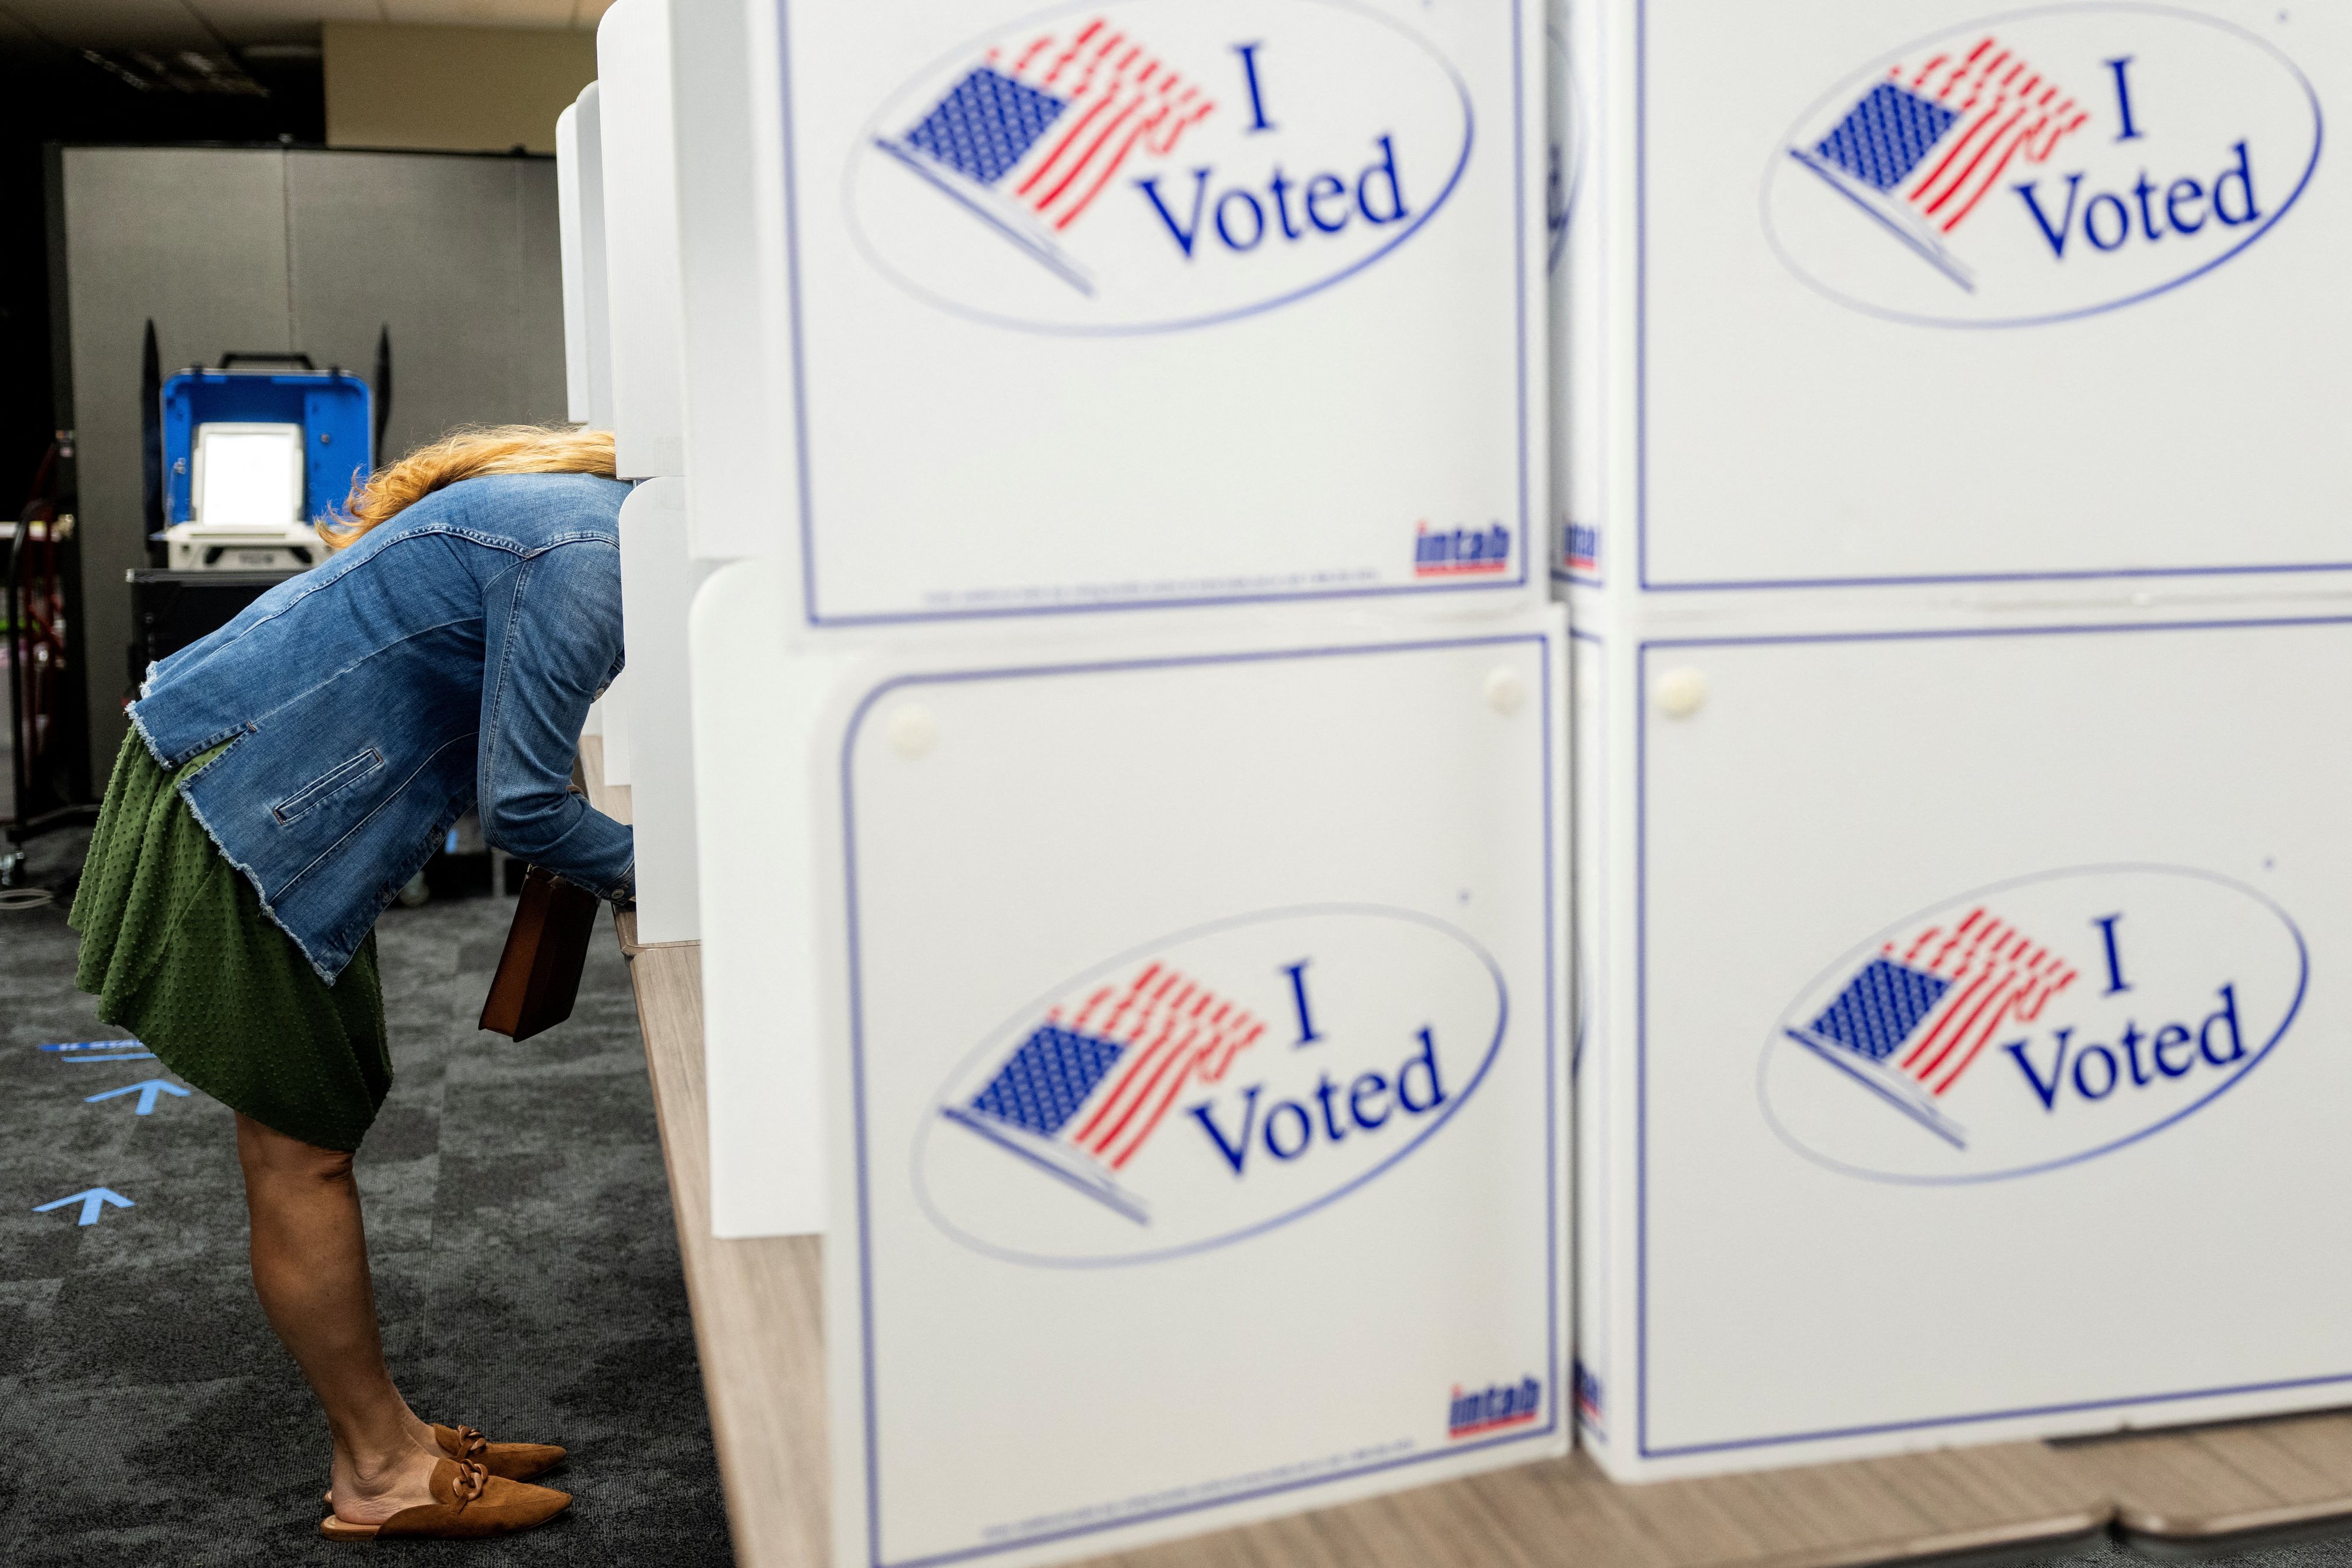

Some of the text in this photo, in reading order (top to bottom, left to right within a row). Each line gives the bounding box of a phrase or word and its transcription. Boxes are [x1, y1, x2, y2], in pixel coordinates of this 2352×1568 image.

[1228, 43, 1277, 132] I
[2103, 56, 2145, 141] I
[1132, 135, 1409, 260] Voted
[2012, 138, 2262, 259] Voted
[1279, 961, 1324, 1045] I
[2091, 914, 2132, 994] I
[2002, 982, 2249, 1111] Voted
[1189, 1027, 1449, 1175] Voted
